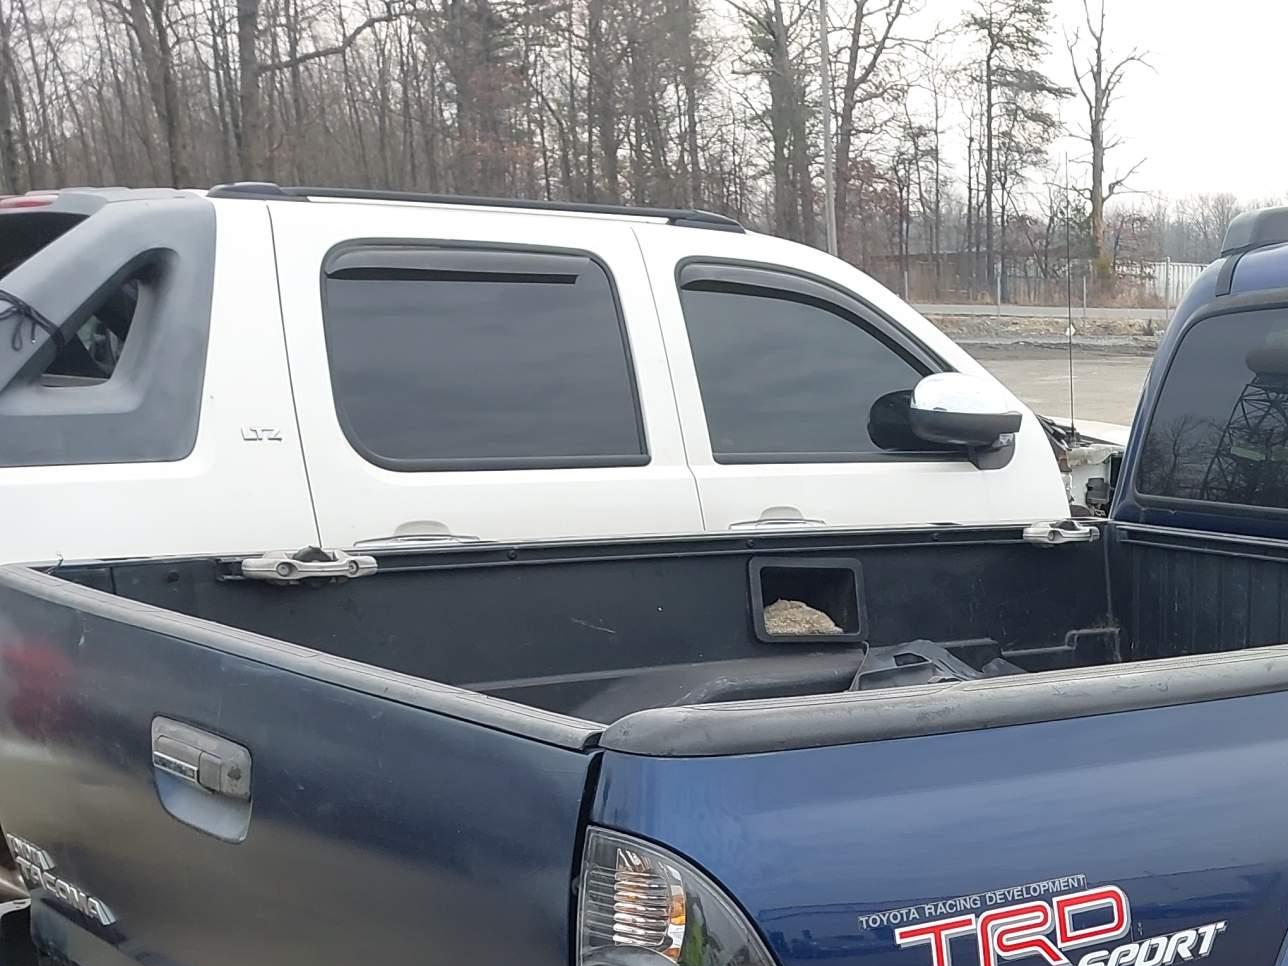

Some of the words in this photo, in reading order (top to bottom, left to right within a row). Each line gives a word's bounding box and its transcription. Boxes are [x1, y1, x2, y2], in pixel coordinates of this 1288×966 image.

[240, 425, 283, 441] LTZ
[15, 855, 114, 926] TACOMA
[859, 908, 921, 930] TOYOTA
[925, 895, 982, 918] RACING
[986, 874, 1086, 906] DEVELOPMENT
